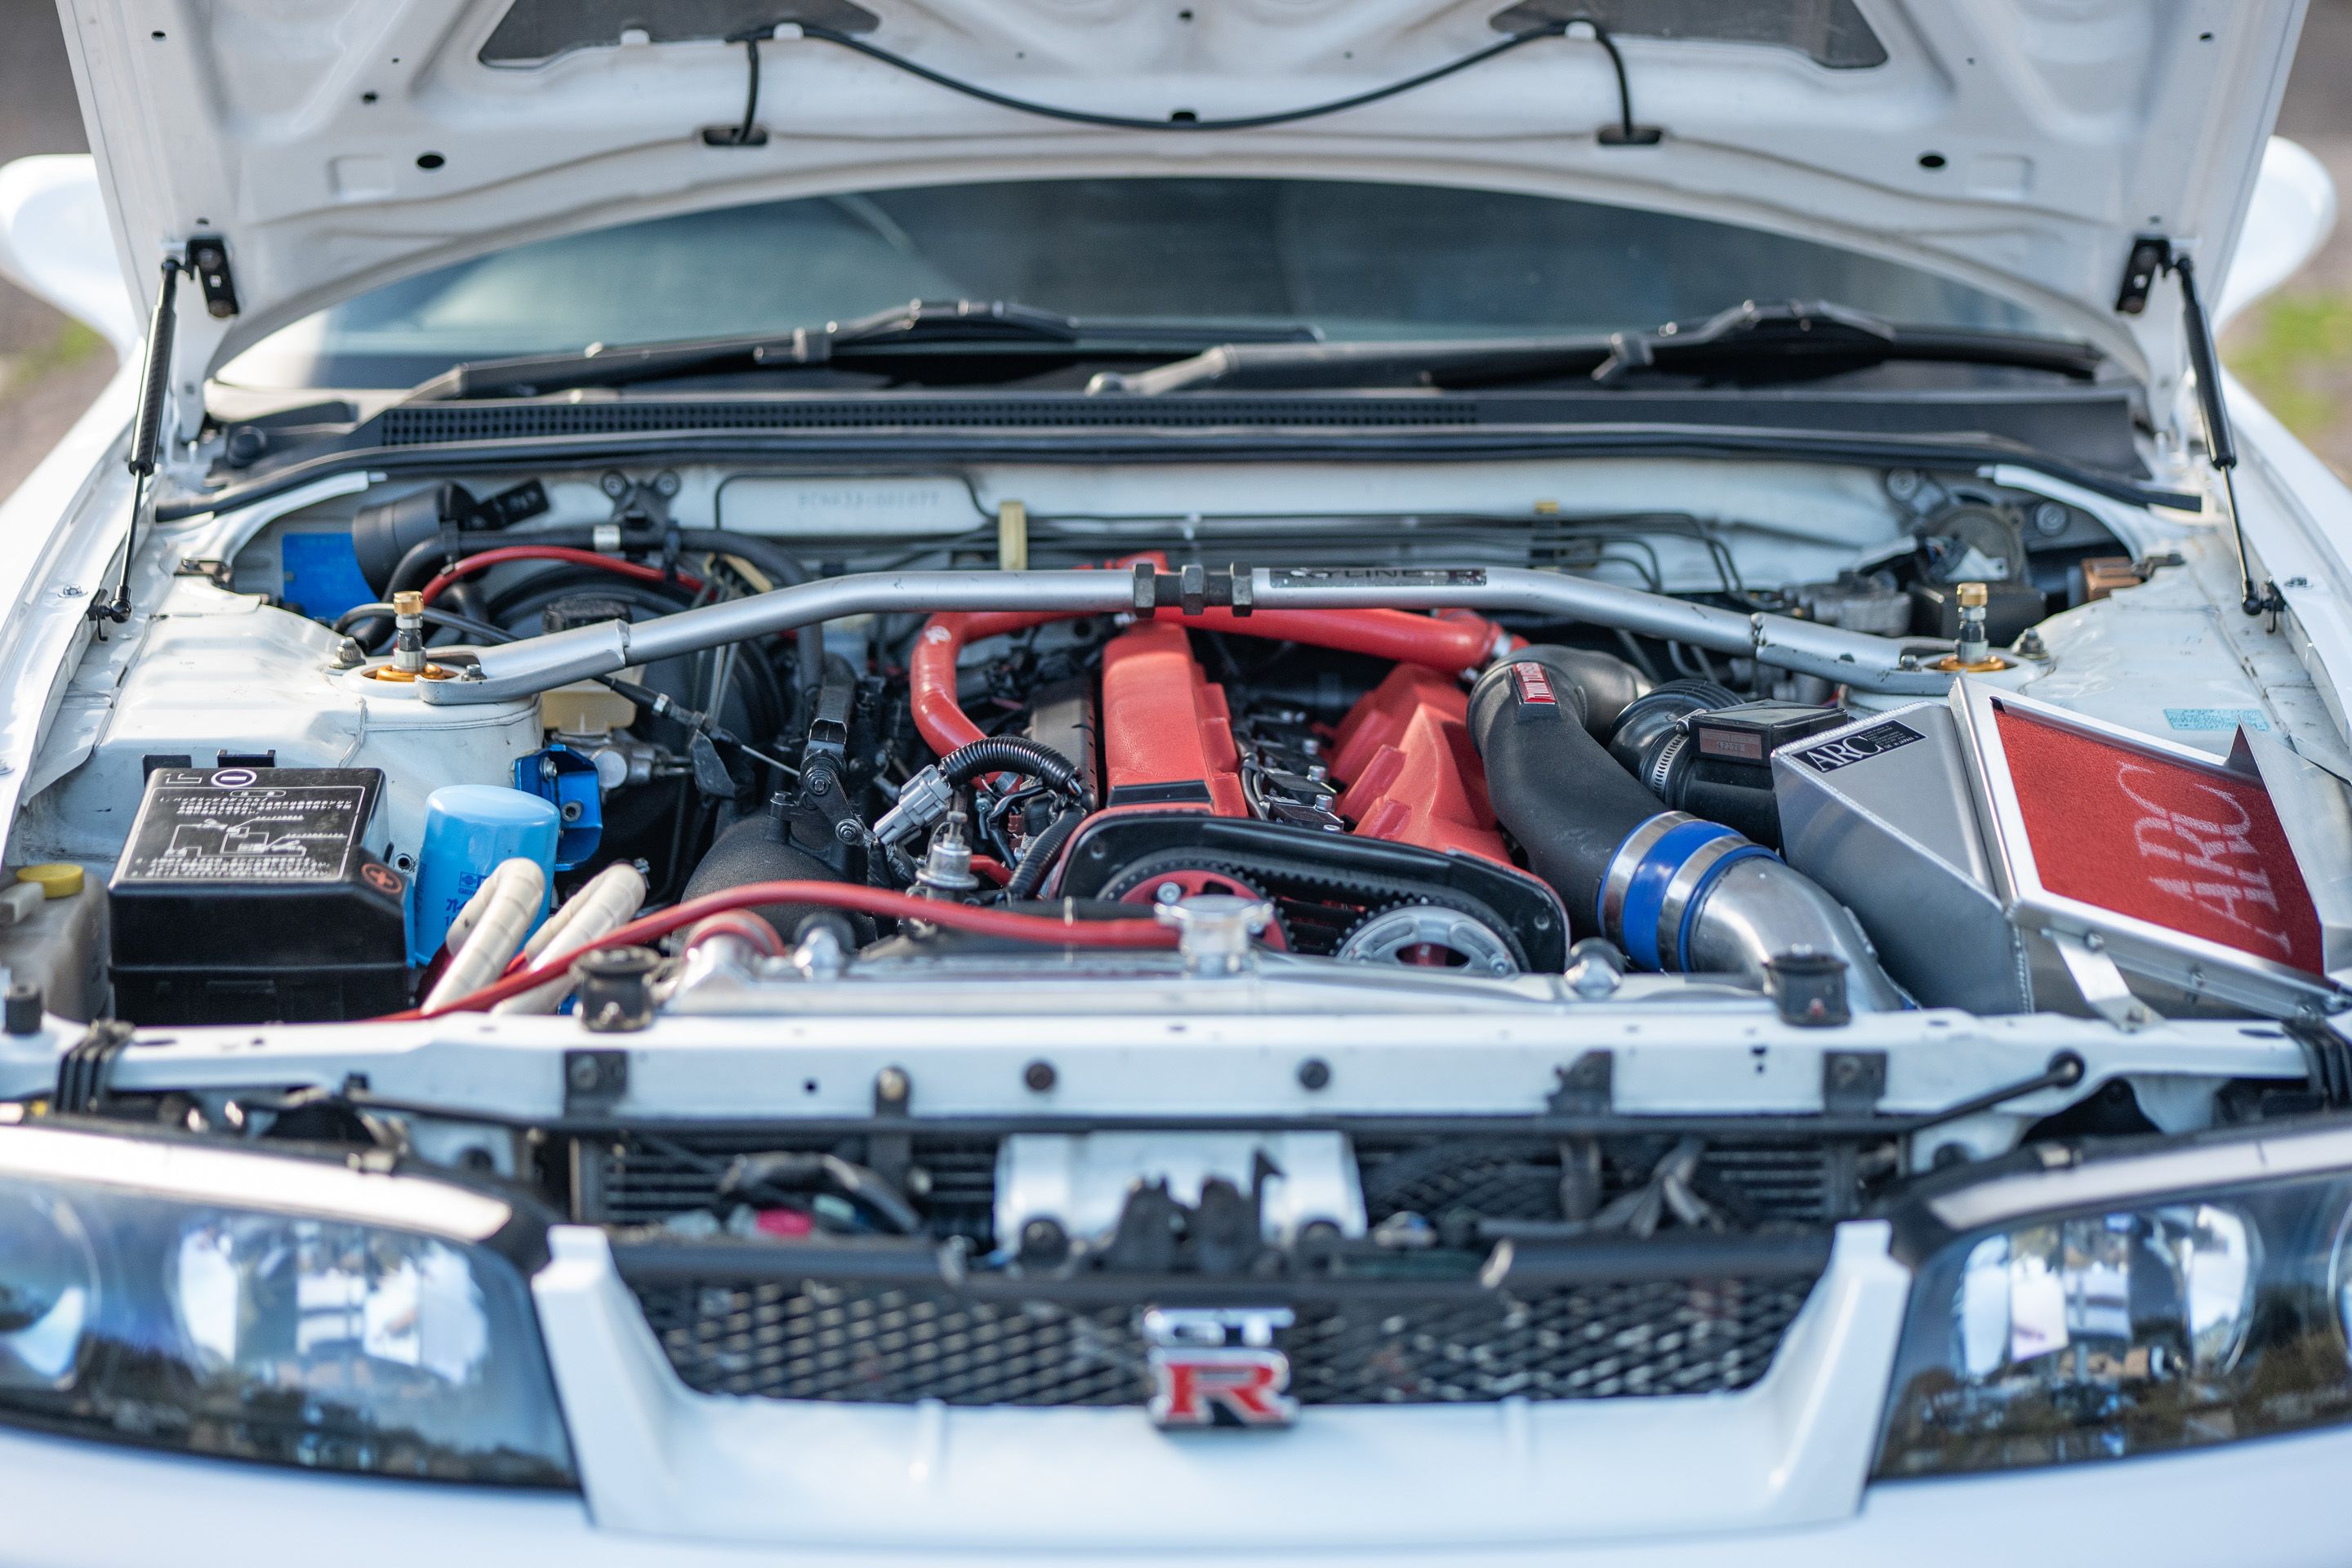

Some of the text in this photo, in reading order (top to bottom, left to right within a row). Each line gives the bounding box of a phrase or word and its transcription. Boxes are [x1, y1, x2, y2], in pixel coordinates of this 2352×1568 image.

[1806, 734, 1885, 772] ARC
[2117, 760, 2292, 956] ARC
[1144, 1307, 1295, 1348] GT
[1147, 1347, 1300, 1426] R
